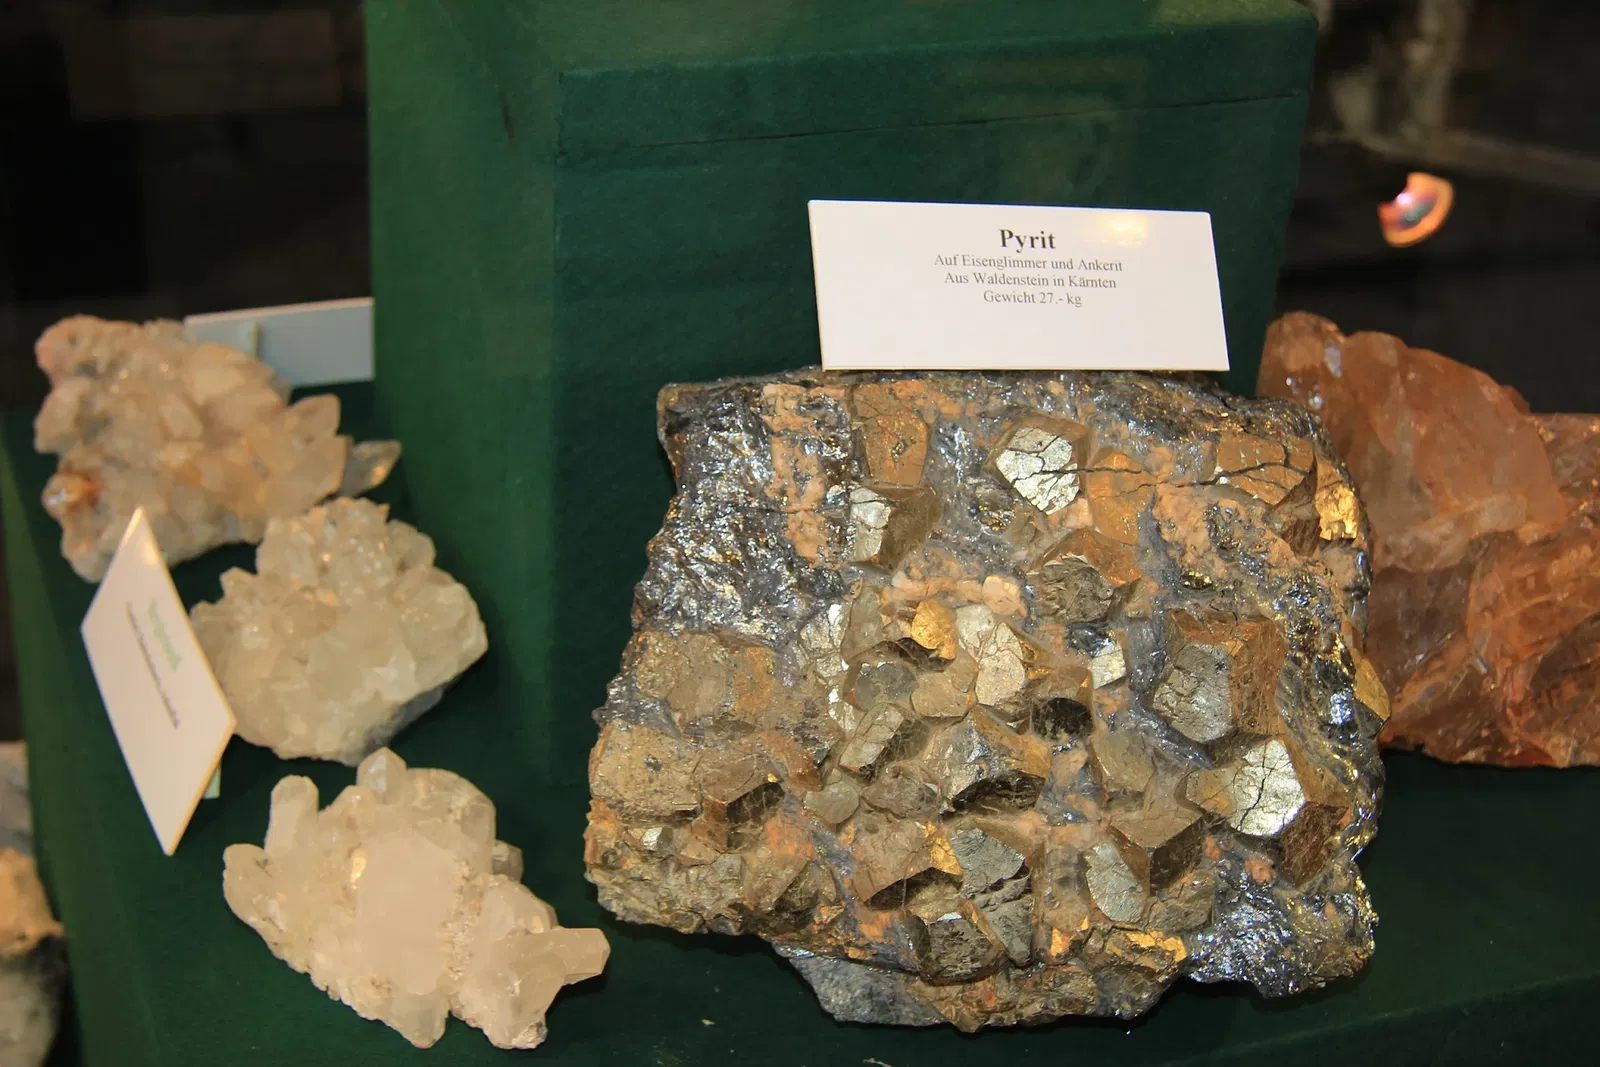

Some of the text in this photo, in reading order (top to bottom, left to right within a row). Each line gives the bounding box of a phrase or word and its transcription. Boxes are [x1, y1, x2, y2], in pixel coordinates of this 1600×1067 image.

[999, 228, 1057, 253] Pyrit
[934, 254, 1123, 272] Auf Eisenglimmer und Ankerit
[944, 272, 1117, 289] Aus Waldenstein in Kärnten
[983, 290, 1036, 304] Gewicht
[1066, 292, 1083, 308] kg
